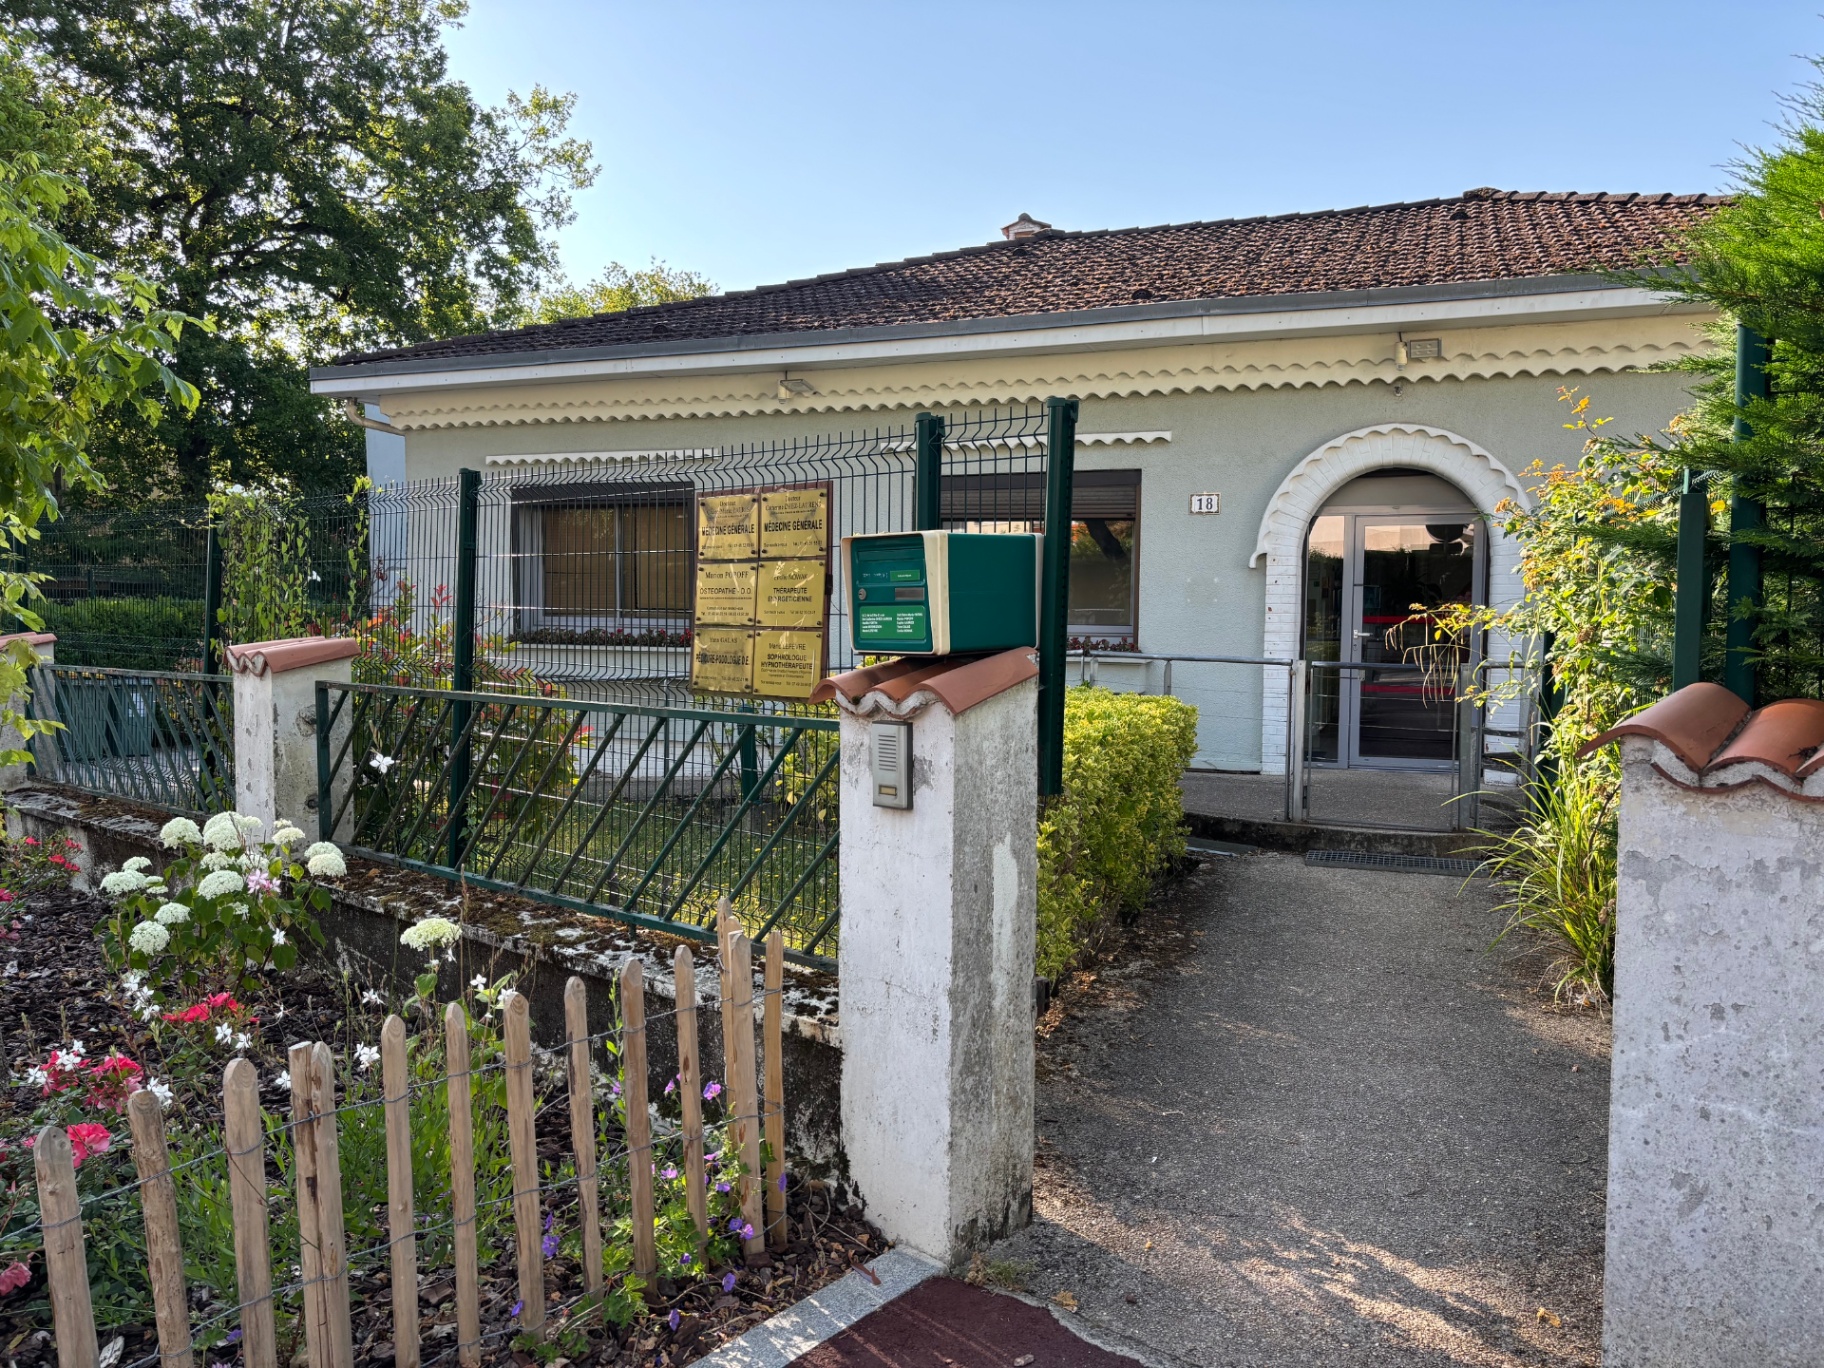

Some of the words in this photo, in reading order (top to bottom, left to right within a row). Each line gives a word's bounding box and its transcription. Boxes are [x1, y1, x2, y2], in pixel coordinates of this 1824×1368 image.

[1196, 497, 1213, 511] 18
[727, 522, 755, 535] GÉNÉRALE
[792, 518, 823, 531] GÉNÉRALE
